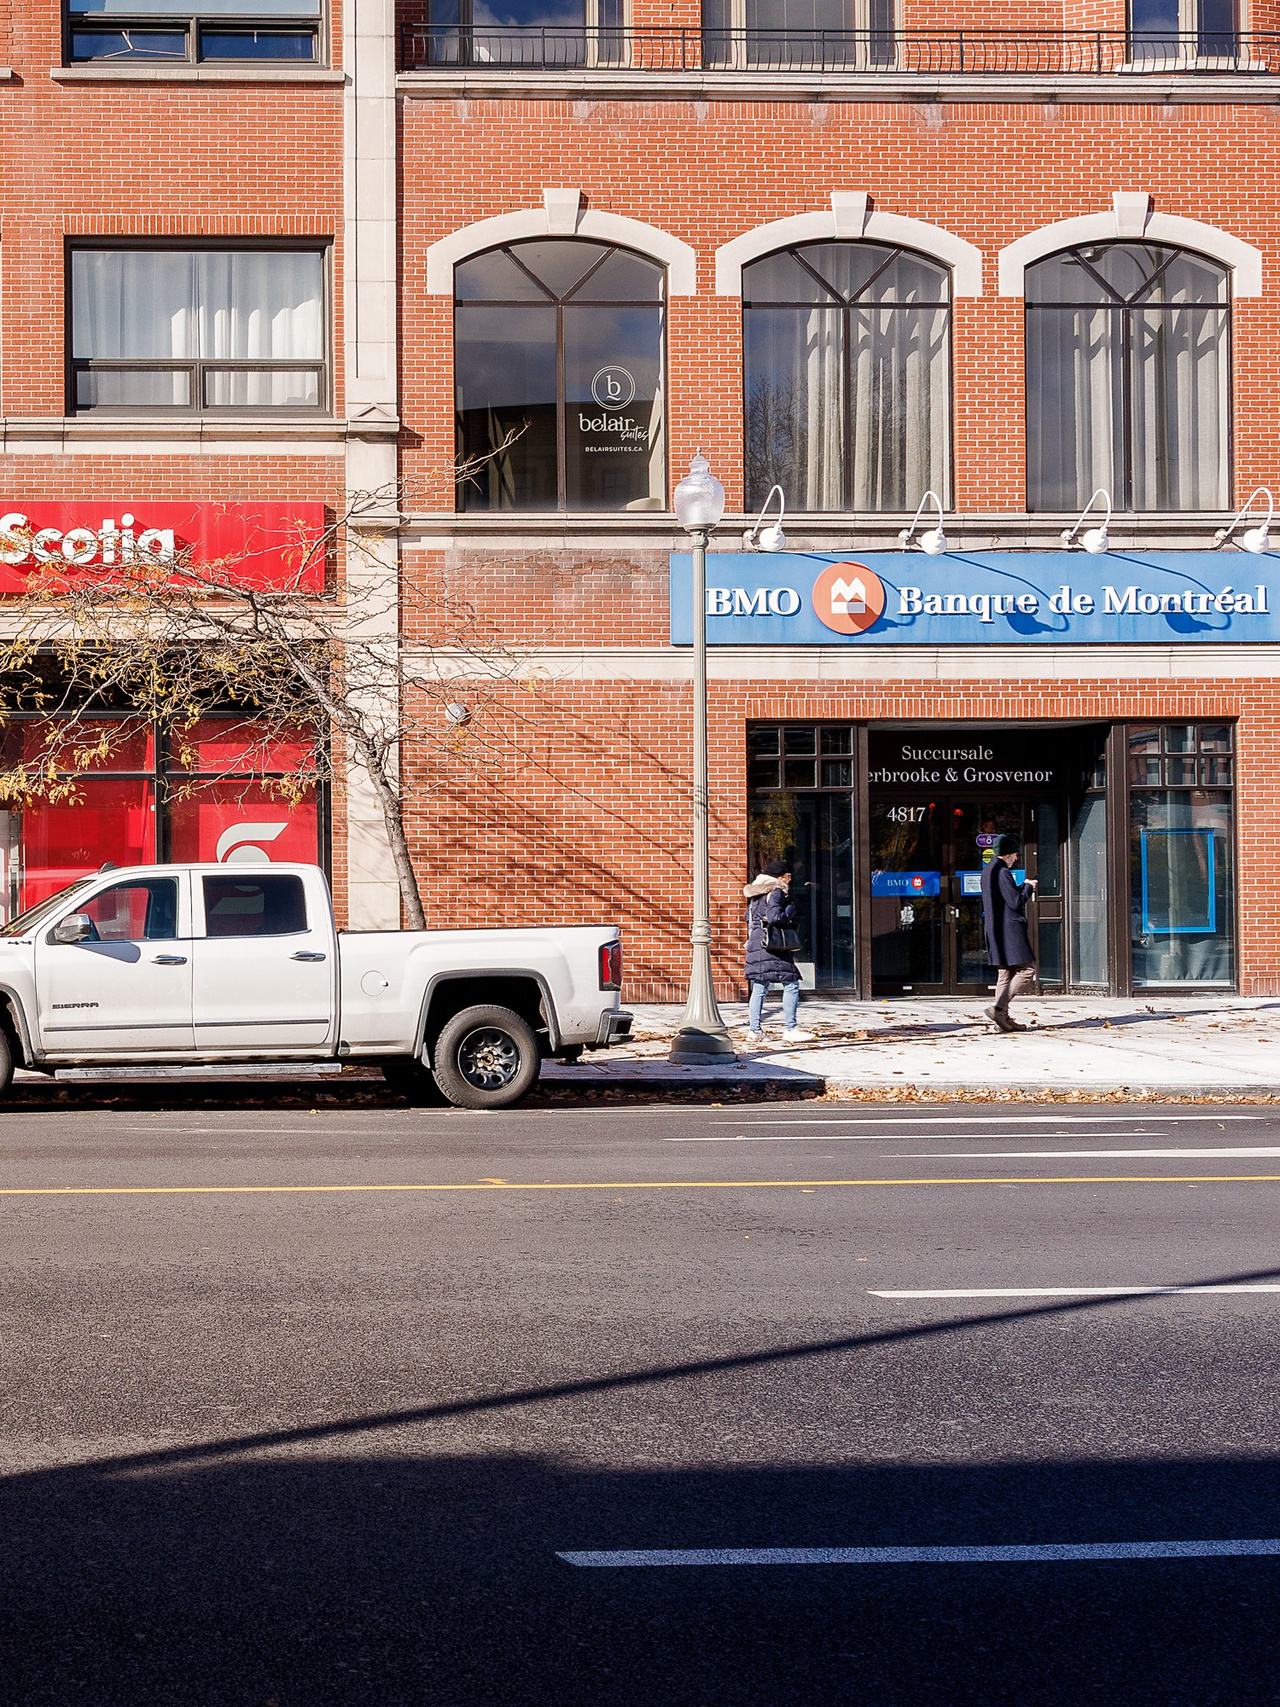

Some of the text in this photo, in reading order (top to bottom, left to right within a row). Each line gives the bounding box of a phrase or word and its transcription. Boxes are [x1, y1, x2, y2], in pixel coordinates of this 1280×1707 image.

[578, 413, 635, 432] belair
[620, 425, 649, 441] suites
[706, 586, 1269, 622] BMO Banque de Montréal
[901, 745, 993, 760] Succursale
[945, 767, 959, 782] &
[963, 767, 1053, 782] Grosvenor
[887, 806, 926, 822] 4817
[887, 879, 908, 887] BMO
